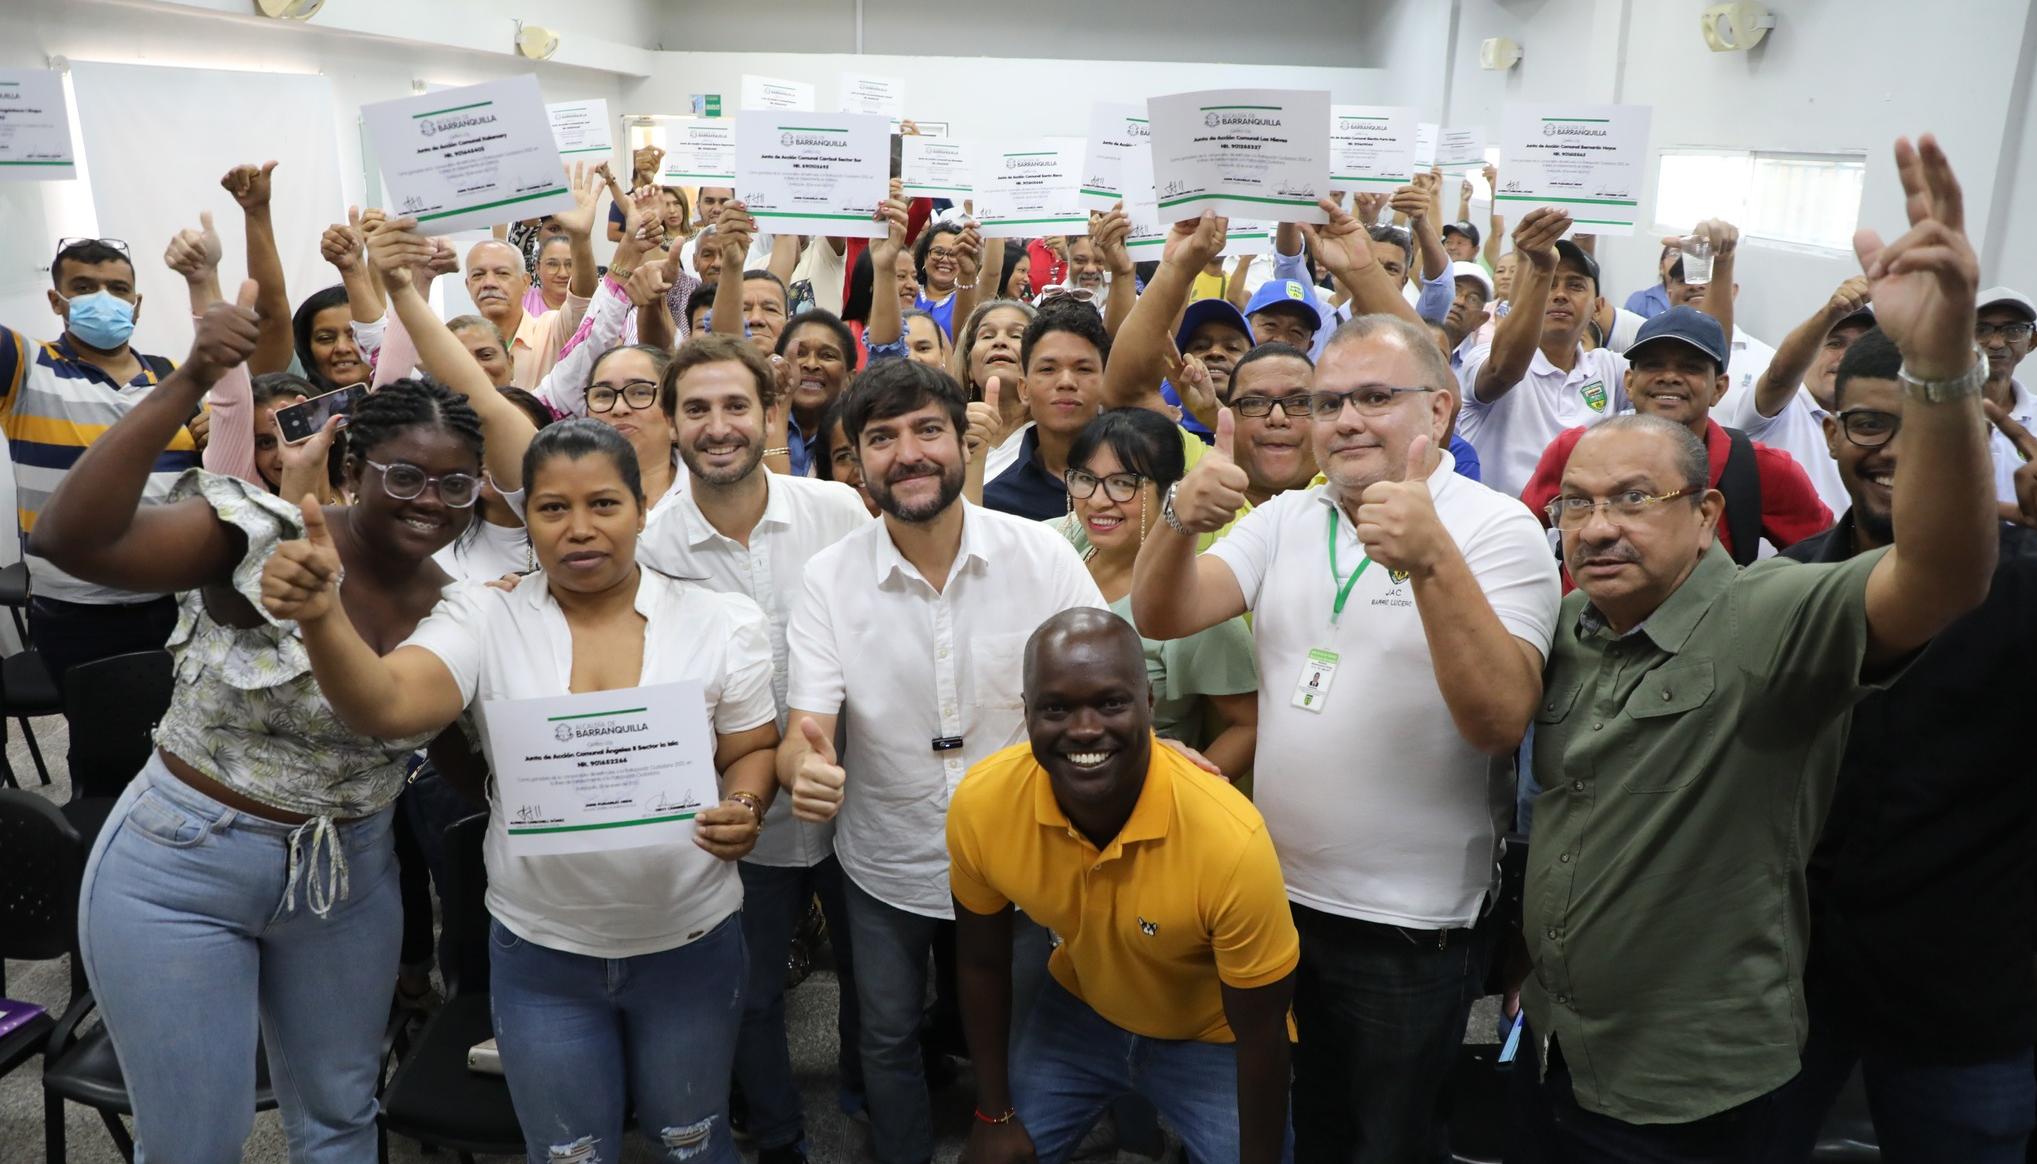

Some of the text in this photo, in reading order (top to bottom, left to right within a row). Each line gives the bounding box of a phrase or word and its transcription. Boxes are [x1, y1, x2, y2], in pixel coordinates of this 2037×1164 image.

[438, 115, 497, 131] BARRANQUILLA
[796, 139, 847, 147] BARRANQUILLA
[1385, 589, 1402, 597] JAC
[576, 722, 649, 738] BARRANQUILLA
[553, 752, 575, 760] Acción
[575, 749, 604, 758] Comunal
[605, 745, 632, 755] Ángeles
